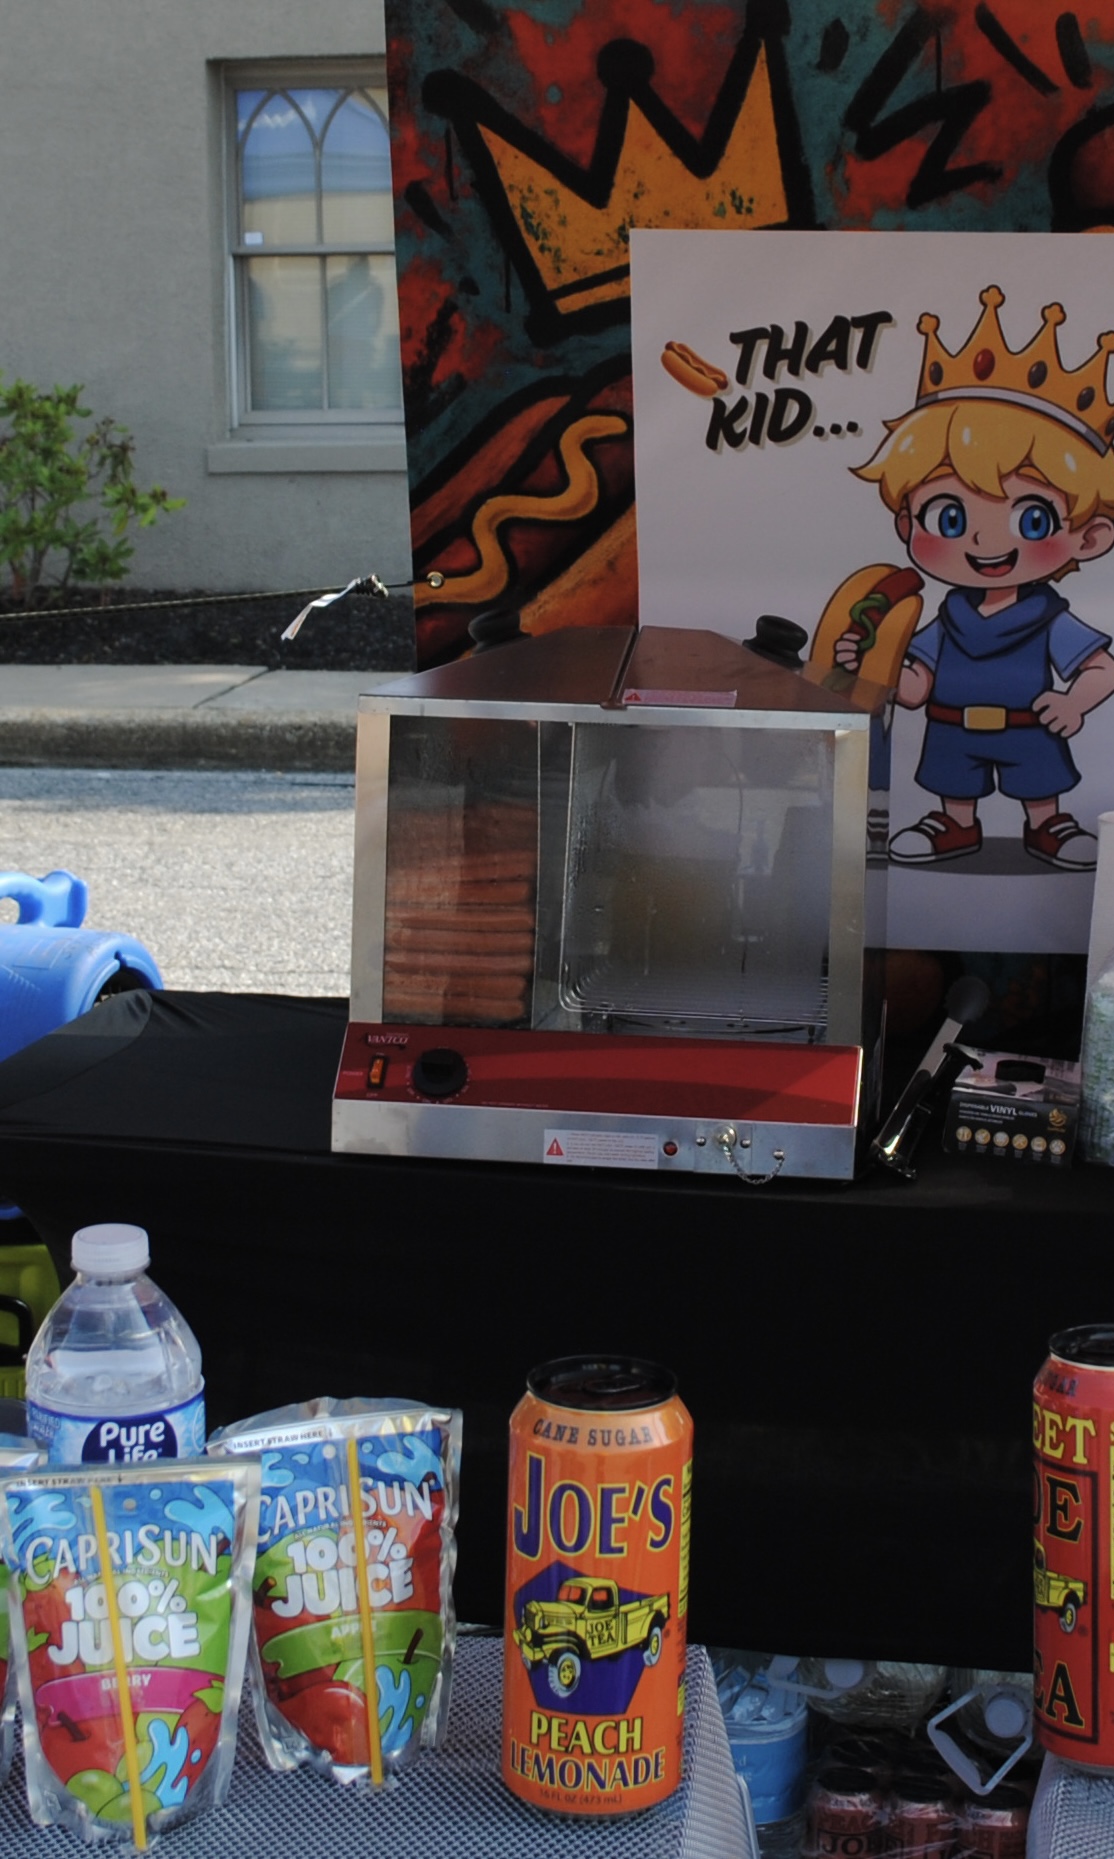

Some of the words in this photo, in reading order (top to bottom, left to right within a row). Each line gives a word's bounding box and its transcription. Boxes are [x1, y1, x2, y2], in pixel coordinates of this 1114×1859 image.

[729, 311, 893, 385] THAT
[705, 387, 859, 451] KID...
[990, 1104, 1018, 1116] VINYL
[100, 1421, 165, 1447] Pure
[233, 1438, 266, 1449] INSERT
[267, 1433, 299, 1446] STRAW
[300, 1430, 323, 1440] HERE
[533, 1418, 580, 1445] CANE
[587, 1426, 654, 1447] SUGAR
[512, 1450, 676, 1561] JOE'S
[25, 1523, 218, 1585] CAPRISUN
[287, 1527, 407, 1574] 100%
[65, 1578, 187, 1621] 100%
[271, 1559, 414, 1618] JUICE
[587, 1631, 617, 1647] TEA
[588, 1619, 615, 1634] JOE
[530, 1710, 643, 1756] PEACH
[510, 1737, 666, 1792] LEMONADE
